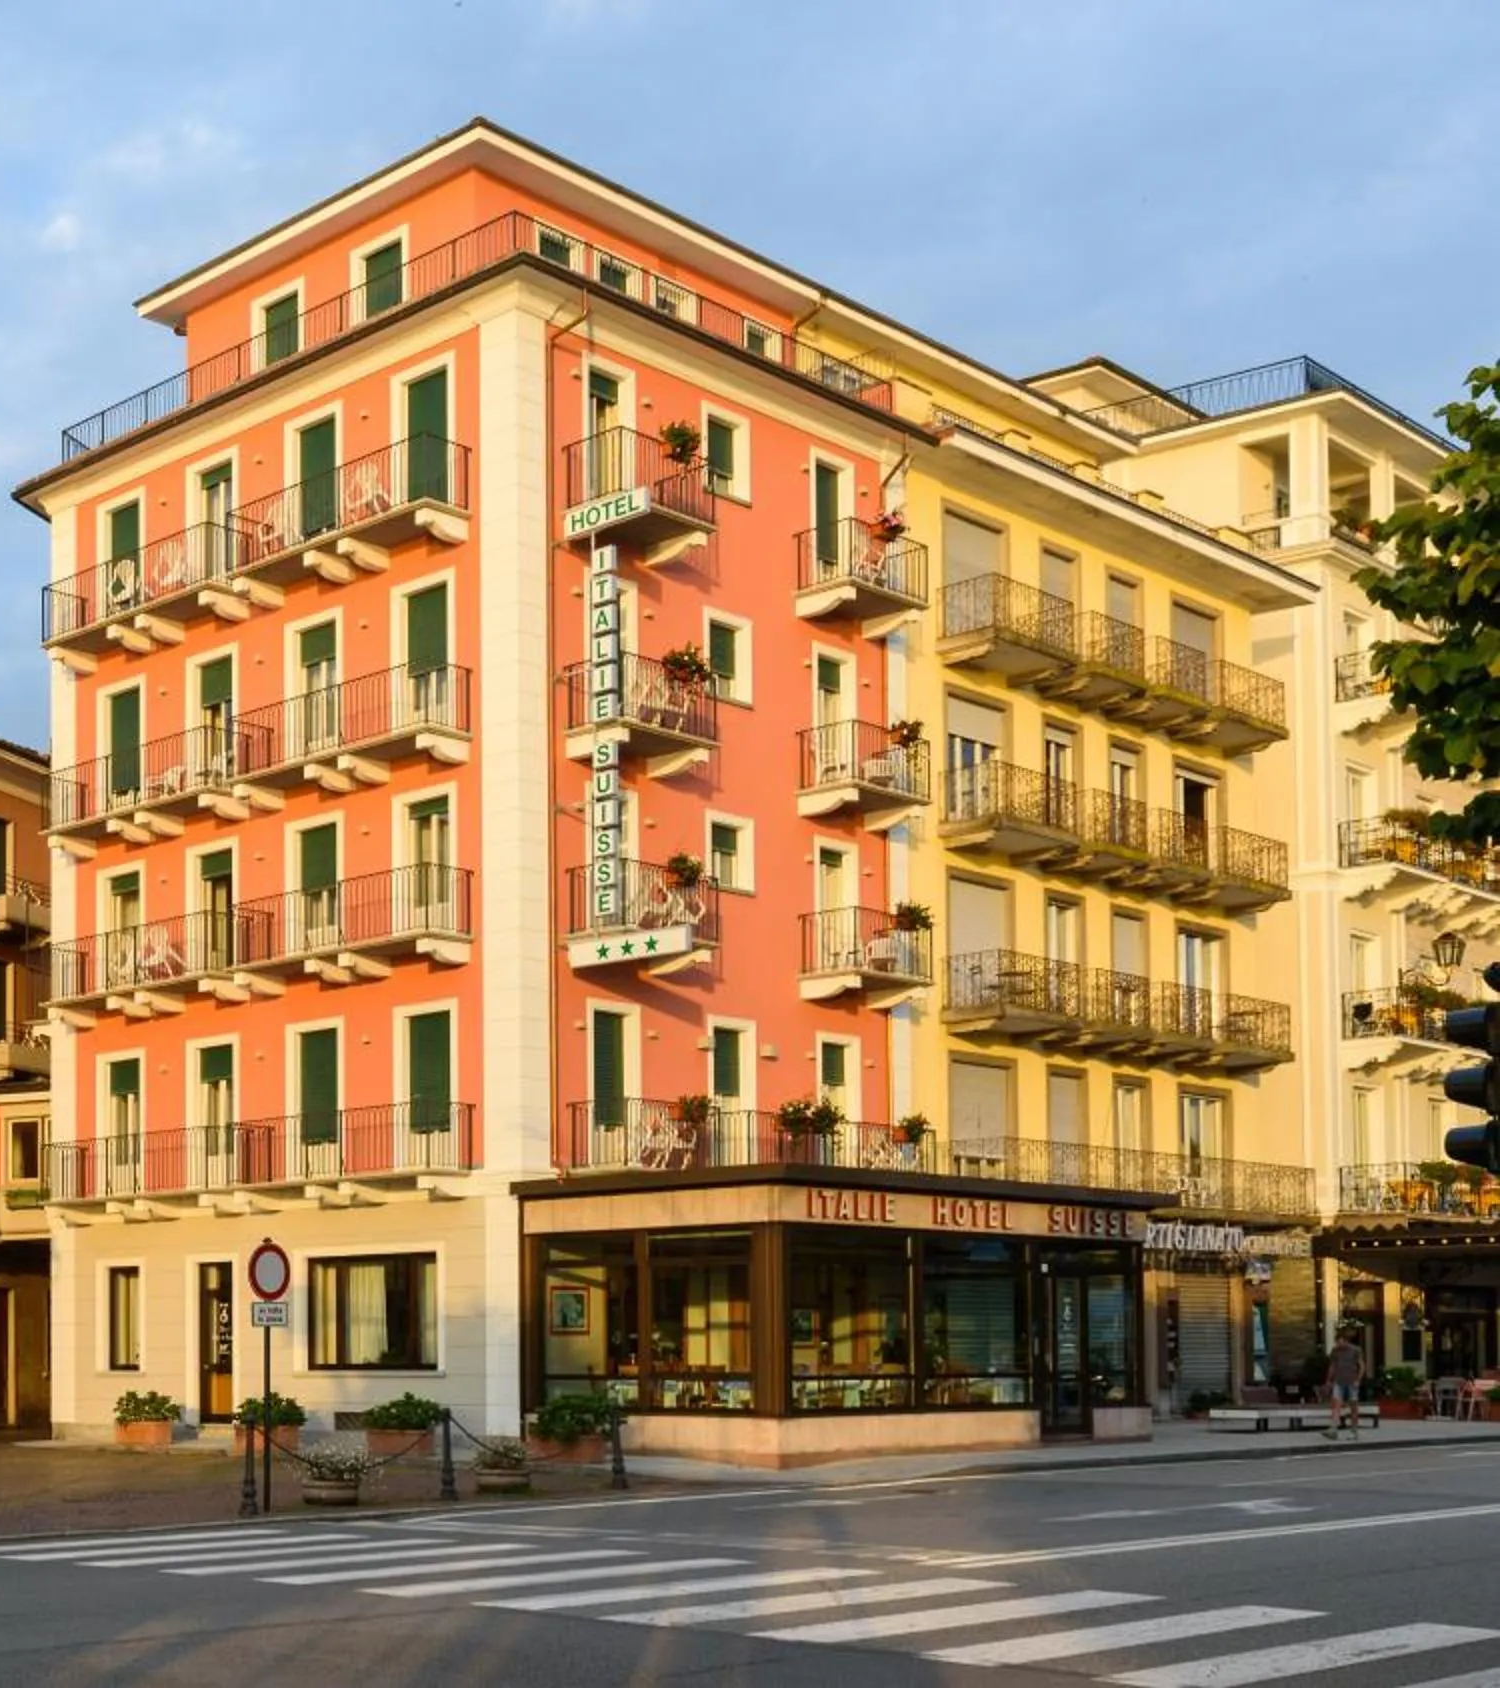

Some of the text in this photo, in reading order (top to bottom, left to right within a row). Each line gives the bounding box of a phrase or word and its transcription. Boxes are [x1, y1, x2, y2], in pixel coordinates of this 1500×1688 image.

[570, 495, 640, 533] HOTEL
[595, 551, 610, 719] ITALIE
[596, 744, 611, 913] SUISSE
[806, 1186, 1135, 1239] ITALIE HOTEL SUISSE
[1143, 1222, 1245, 1252] RTIGIANATO
